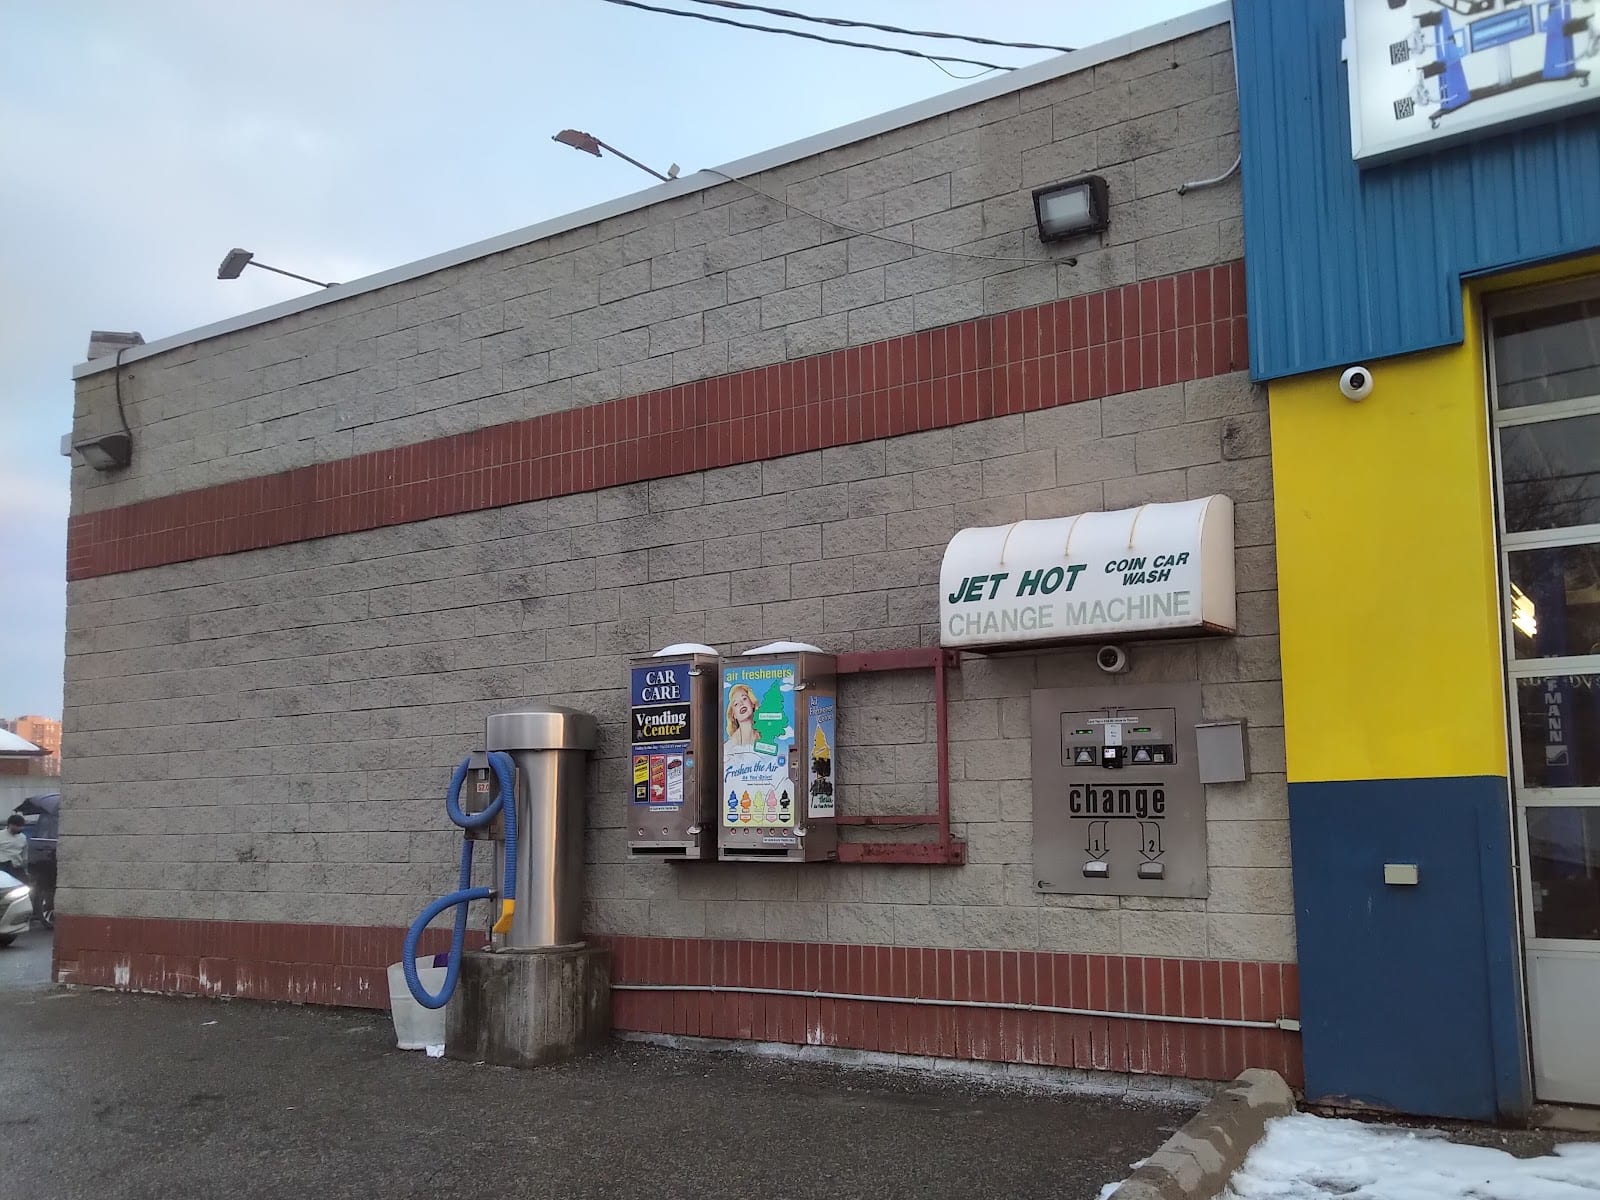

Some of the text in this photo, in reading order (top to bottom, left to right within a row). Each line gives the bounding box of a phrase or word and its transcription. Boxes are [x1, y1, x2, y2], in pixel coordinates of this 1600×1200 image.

[1105, 552, 1190, 574] COIN CAR
[949, 564, 1087, 604] JET HOT
[1122, 569, 1171, 586] WASH
[948, 591, 1191, 637] CHANGE MACHINE
[646, 670, 676, 685] CAR
[726, 668, 792, 681] air fresheners
[642, 685, 681, 701] CARE
[636, 711, 687, 727] Vending
[643, 724, 681, 737] Center
[1065, 748, 1071, 759] 1
[1122, 746, 1128, 758] 2
[725, 761, 779, 783] Freshen the Air
[1069, 784, 1166, 819] change
[1094, 840, 1100, 851] 1
[1149, 840, 1155, 852] 2
